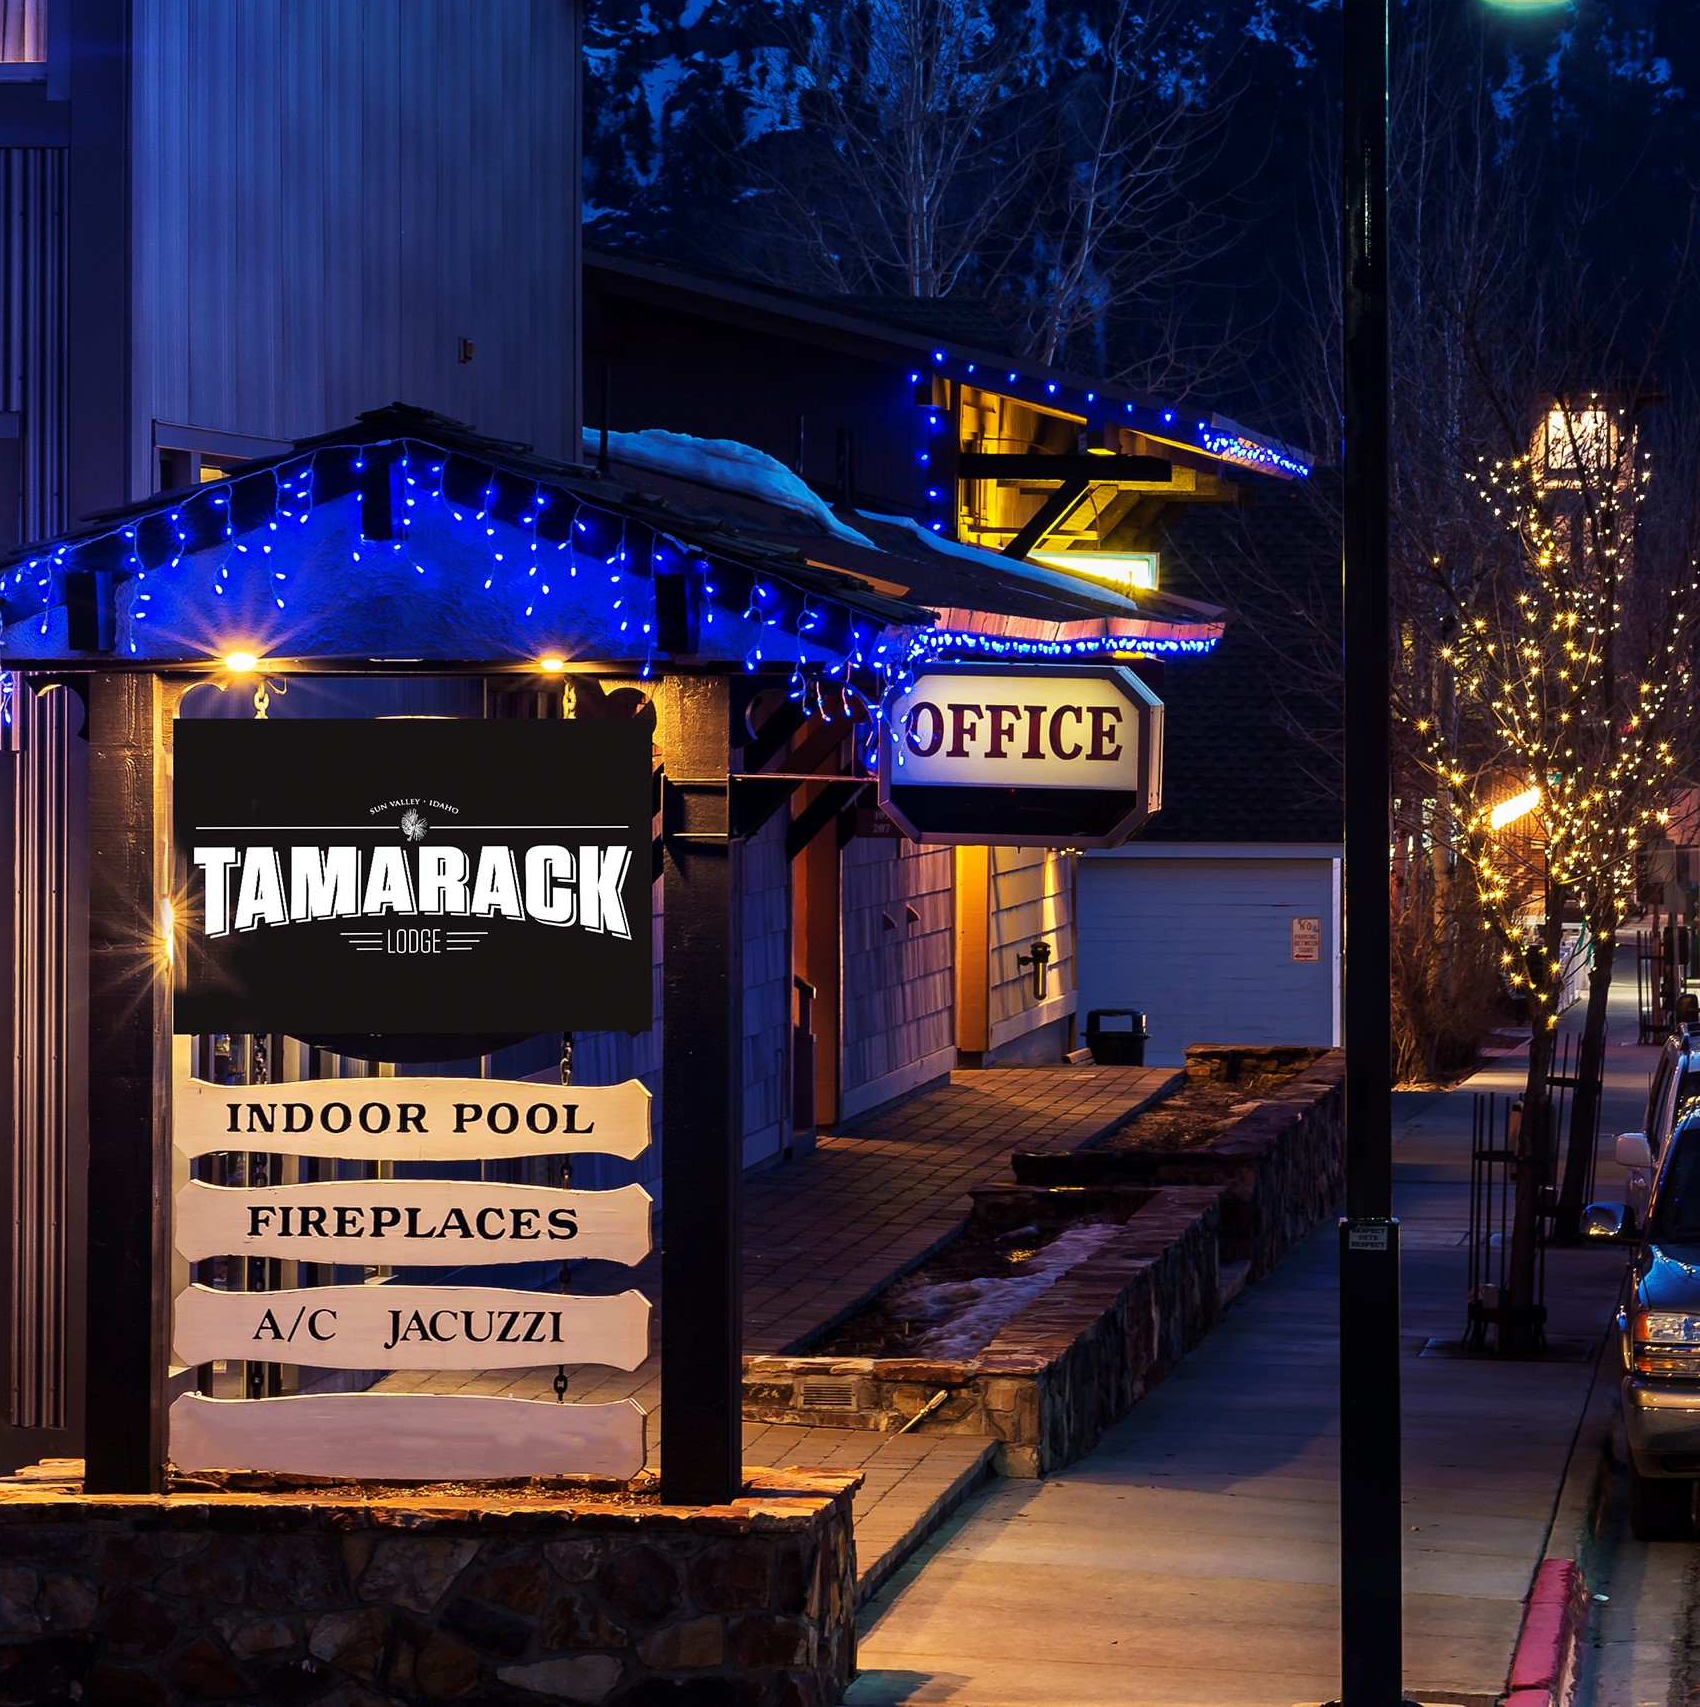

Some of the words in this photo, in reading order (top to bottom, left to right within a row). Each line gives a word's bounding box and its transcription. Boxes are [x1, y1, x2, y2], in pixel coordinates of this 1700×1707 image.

[905, 701, 1123, 761] OFFICE
[369, 802, 388, 815] SUN
[389, 798, 421, 807] VALLEY
[429, 799, 459, 814] IDAHO
[193, 845, 632, 941] TAMARACK
[388, 929, 441, 954] LODGE
[1299, 922, 1312, 931] NO
[226, 1102, 428, 1134] INDOOR
[452, 1102, 595, 1134] POOL
[246, 1206, 579, 1240] FIREPLACES
[252, 1306, 337, 1342] A/C
[384, 1309, 564, 1349] JACUZZI
